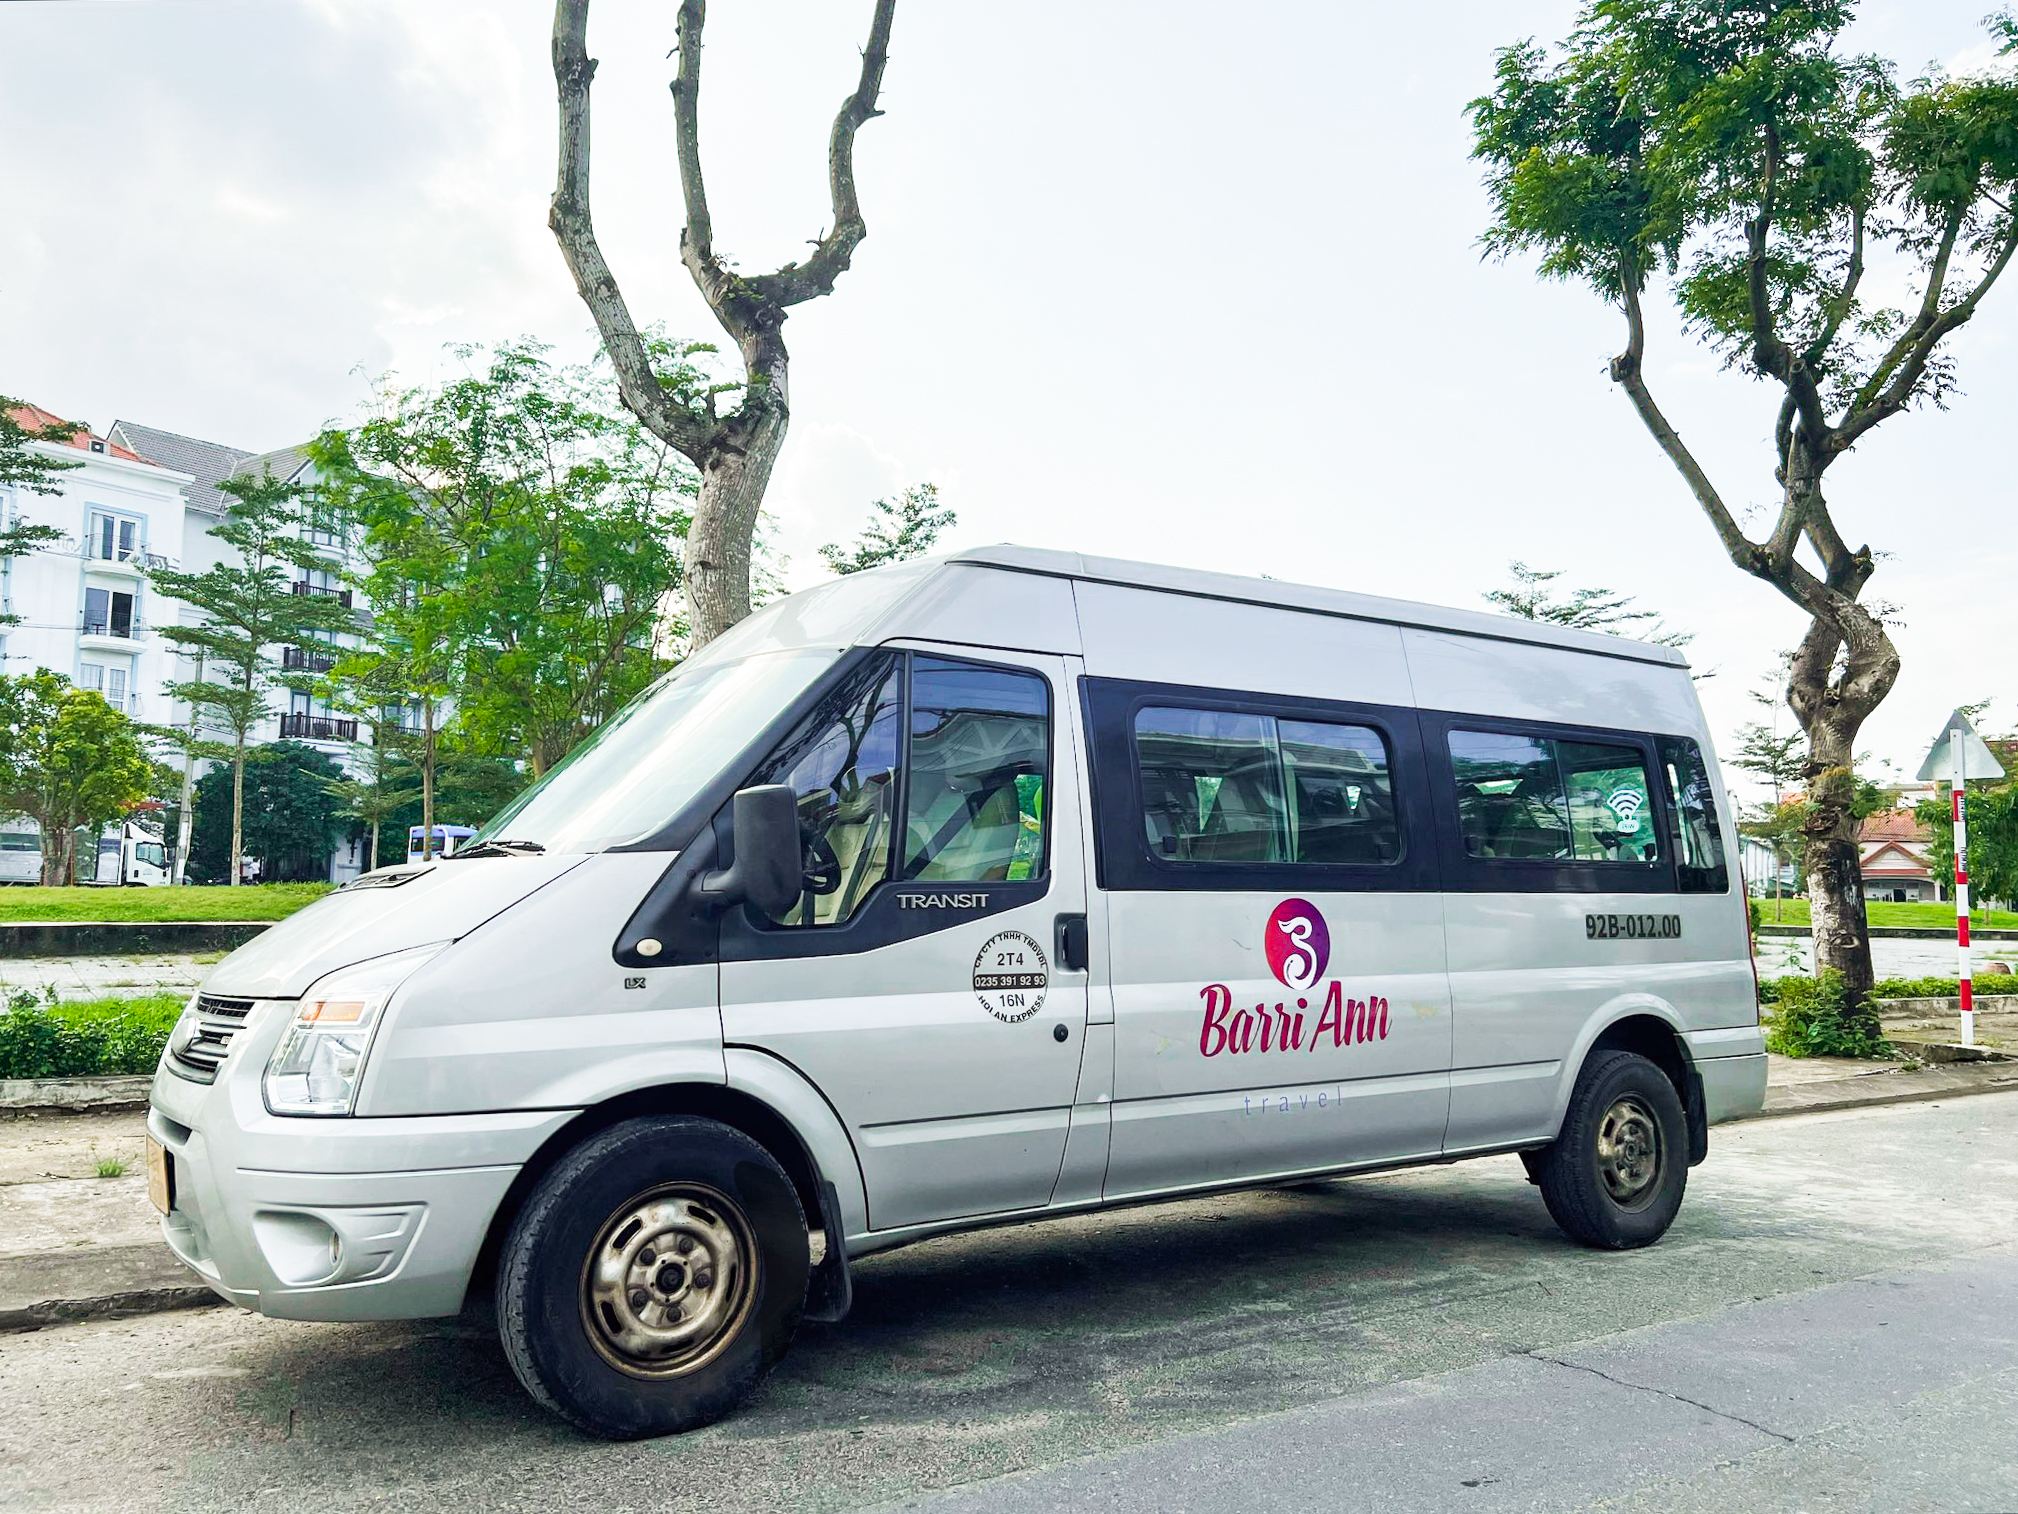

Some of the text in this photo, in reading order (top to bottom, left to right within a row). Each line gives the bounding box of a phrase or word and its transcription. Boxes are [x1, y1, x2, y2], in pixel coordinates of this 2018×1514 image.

[896, 893, 989, 909] TRANSIT
[1586, 915, 1682, 939] 92B-012.00
[981, 937, 996, 954] CTY
[997, 932, 1021, 941] TNHH
[997, 953, 1024, 966] 2T4
[624, 977, 646, 989] LX
[974, 975, 1045, 987] 0235 391 92 93
[978, 995, 1044, 1022] HOI AN EXPRESS
[1000, 994, 1025, 1007] 16N
[1200, 981, 1392, 1058] Barri Ann
[1244, 1085, 1342, 1115] travel
